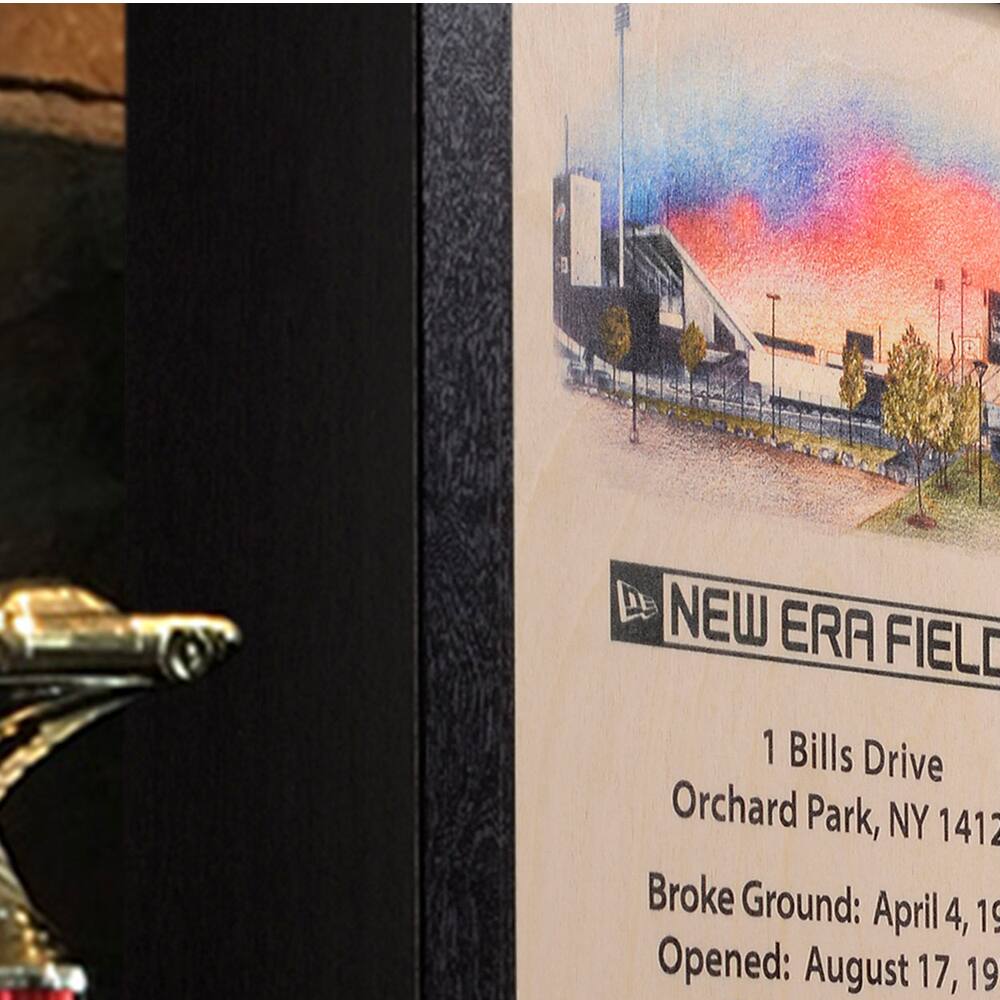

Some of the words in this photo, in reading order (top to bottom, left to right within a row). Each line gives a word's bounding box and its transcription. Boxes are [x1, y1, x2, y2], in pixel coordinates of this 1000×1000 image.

[670, 581, 769, 648] NEW
[781, 599, 874, 662] ERA
[764, 729, 773, 764] 1
[791, 731, 852, 772] Bills
[865, 739, 943, 782] Drive
[673, 780, 796, 828] Orchard
[808, 793, 879, 841] Park,
[890, 801, 929, 839] NY
[649, 872, 734, 915] Broke
[742, 880, 859, 924] Ground:
[874, 890, 937, 936] April
[945, 897, 968, 936] 4,
[659, 936, 789, 985] Opened:
[805, 946, 908, 994] August
[919, 954, 957, 994] 17,
